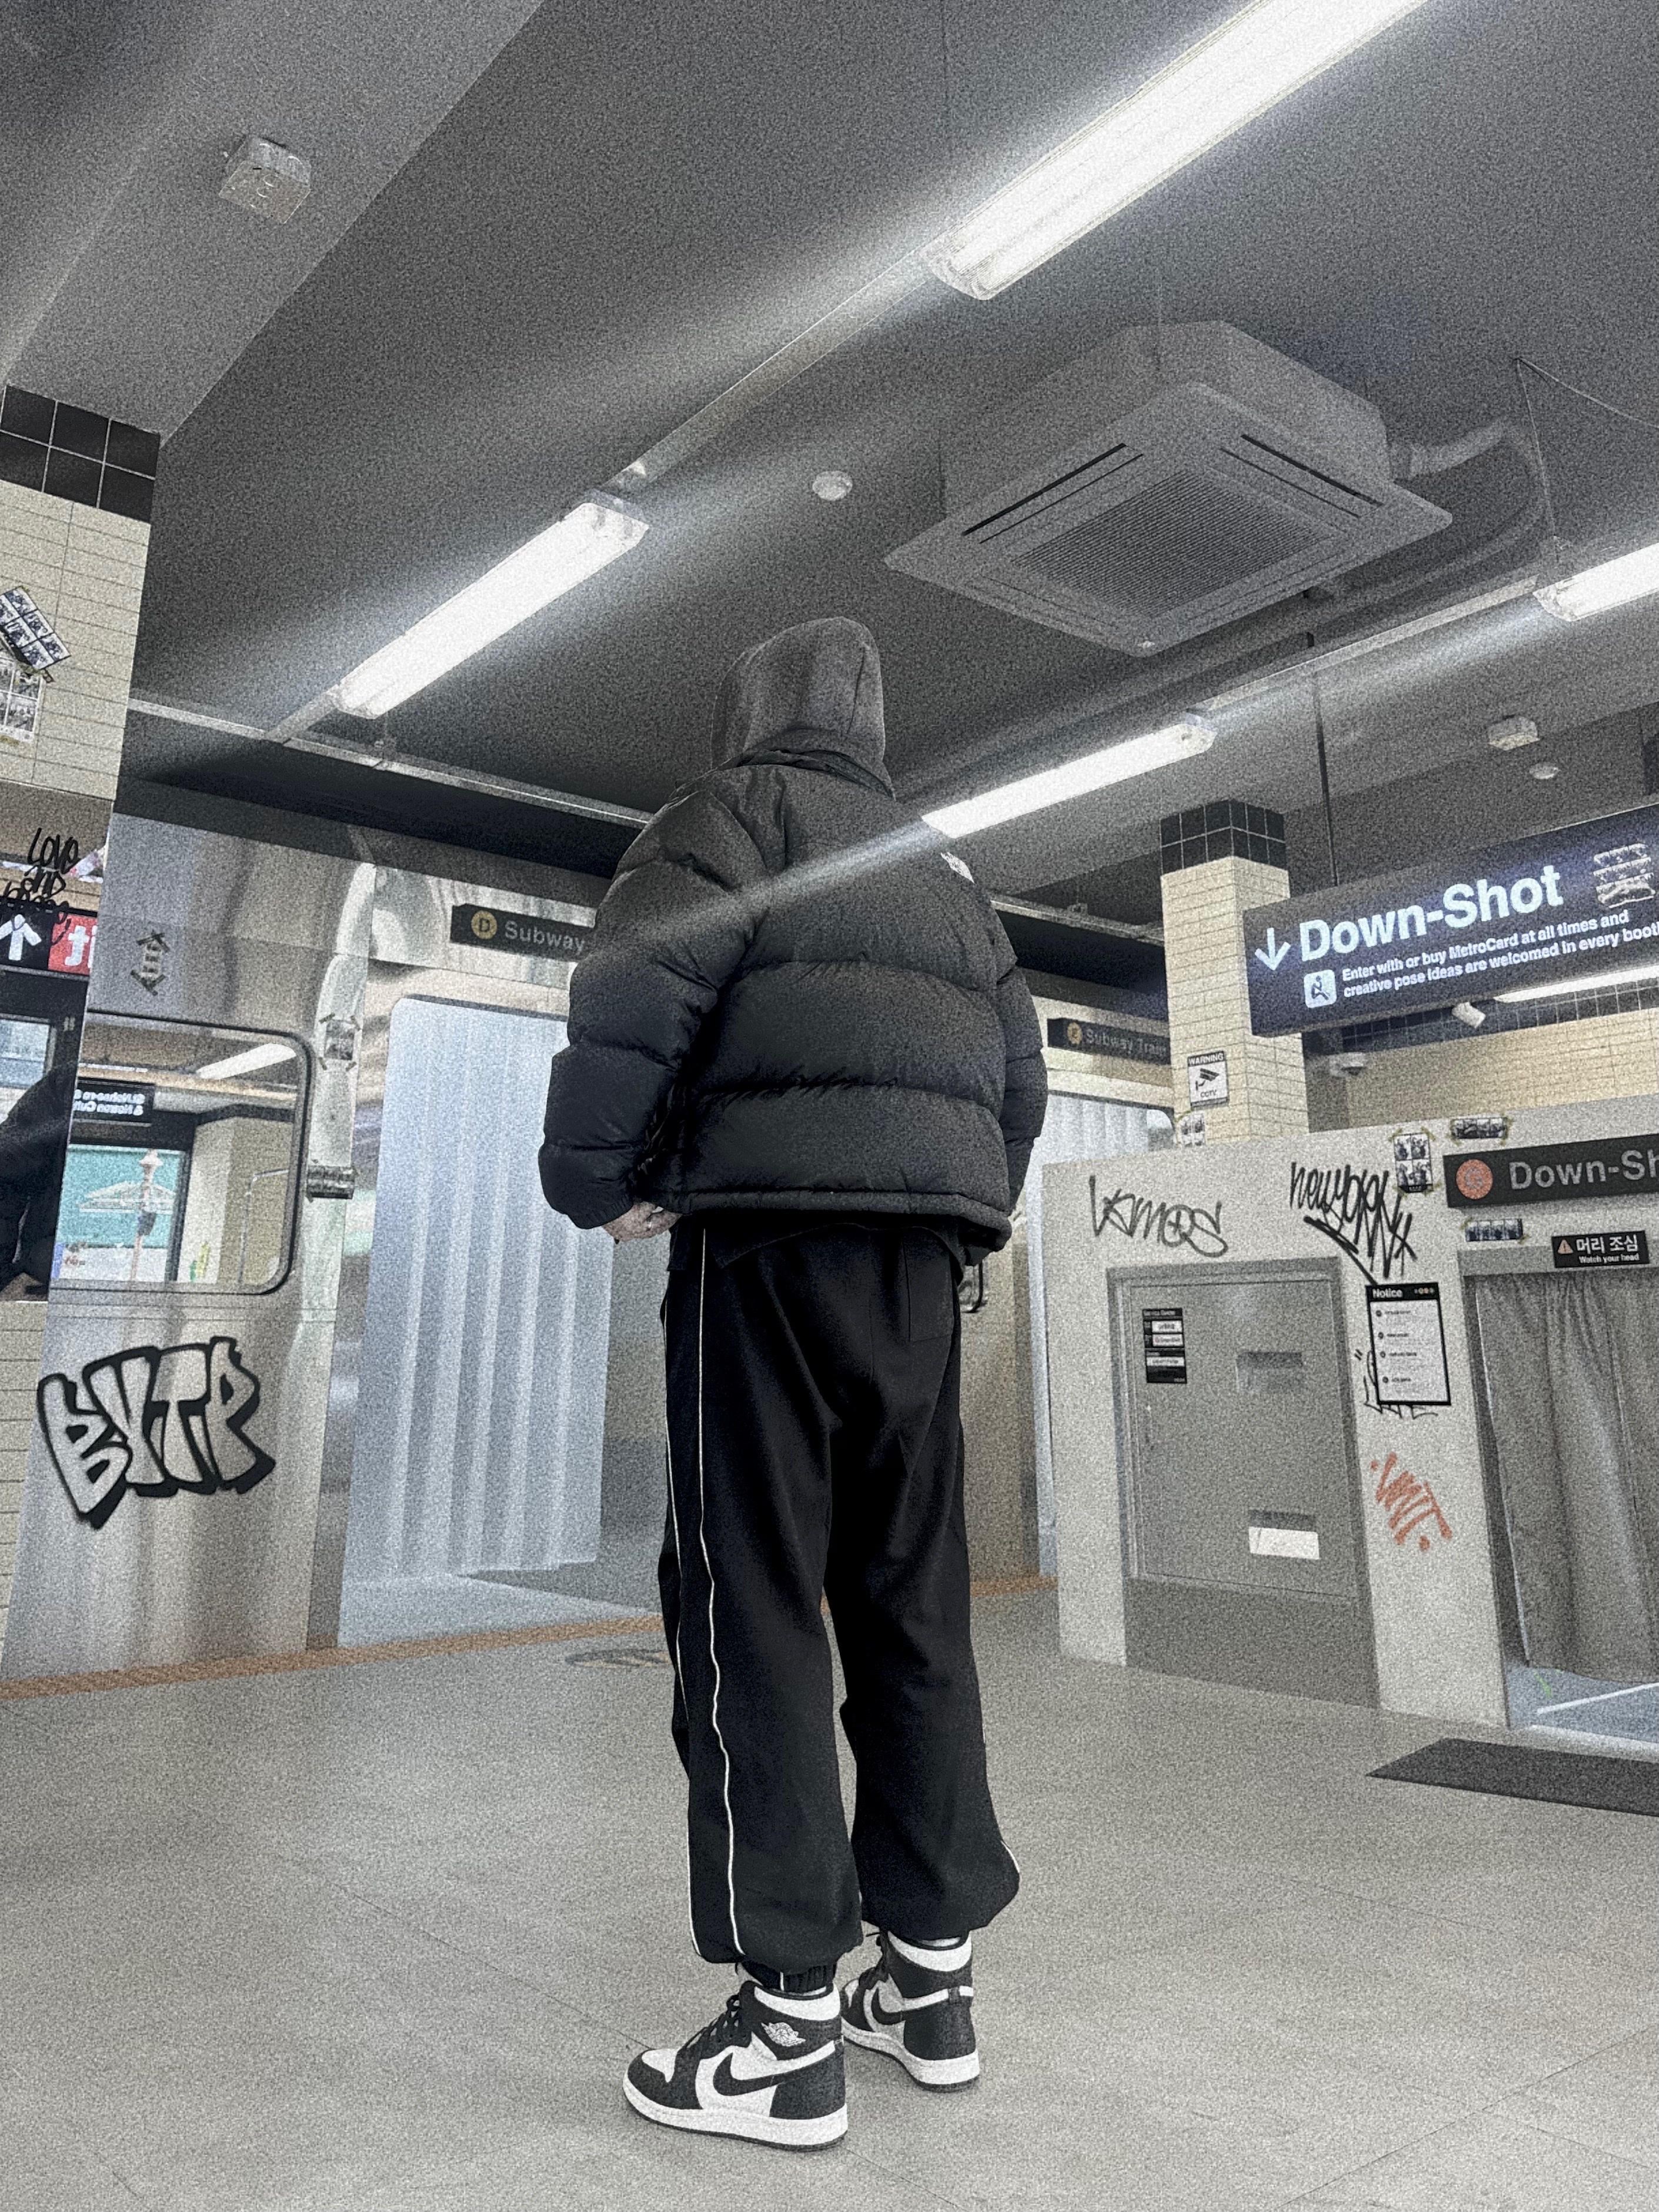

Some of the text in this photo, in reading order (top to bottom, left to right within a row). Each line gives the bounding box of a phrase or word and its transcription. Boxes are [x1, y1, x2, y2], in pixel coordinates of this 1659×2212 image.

[1299, 865, 1564, 962] Down-Shot
[505, 920, 585, 956] Subway
[1342, 909, 1630, 981] Enter with or buy MetroCard at all times and
[1344, 979, 1392, 997] creative
[1394, 972, 1426, 990] pose
[1427, 965, 1463, 981] ideas
[1465, 959, 1487, 973] are
[1488, 942, 1559, 968] welcomed
[1562, 940, 1577, 954] in
[1578, 932, 1620, 947] every
[1086, 1028, 1133, 1054] Subway
[1189, 1052, 1224, 1065] WARNING
[1200, 1089, 1217, 1098] CCTV
[1575, 1234, 1638, 1255] 머리 조심
[1578, 1253, 1640, 1264] Watch your head
[1372, 1287, 1404, 1299] Notice
